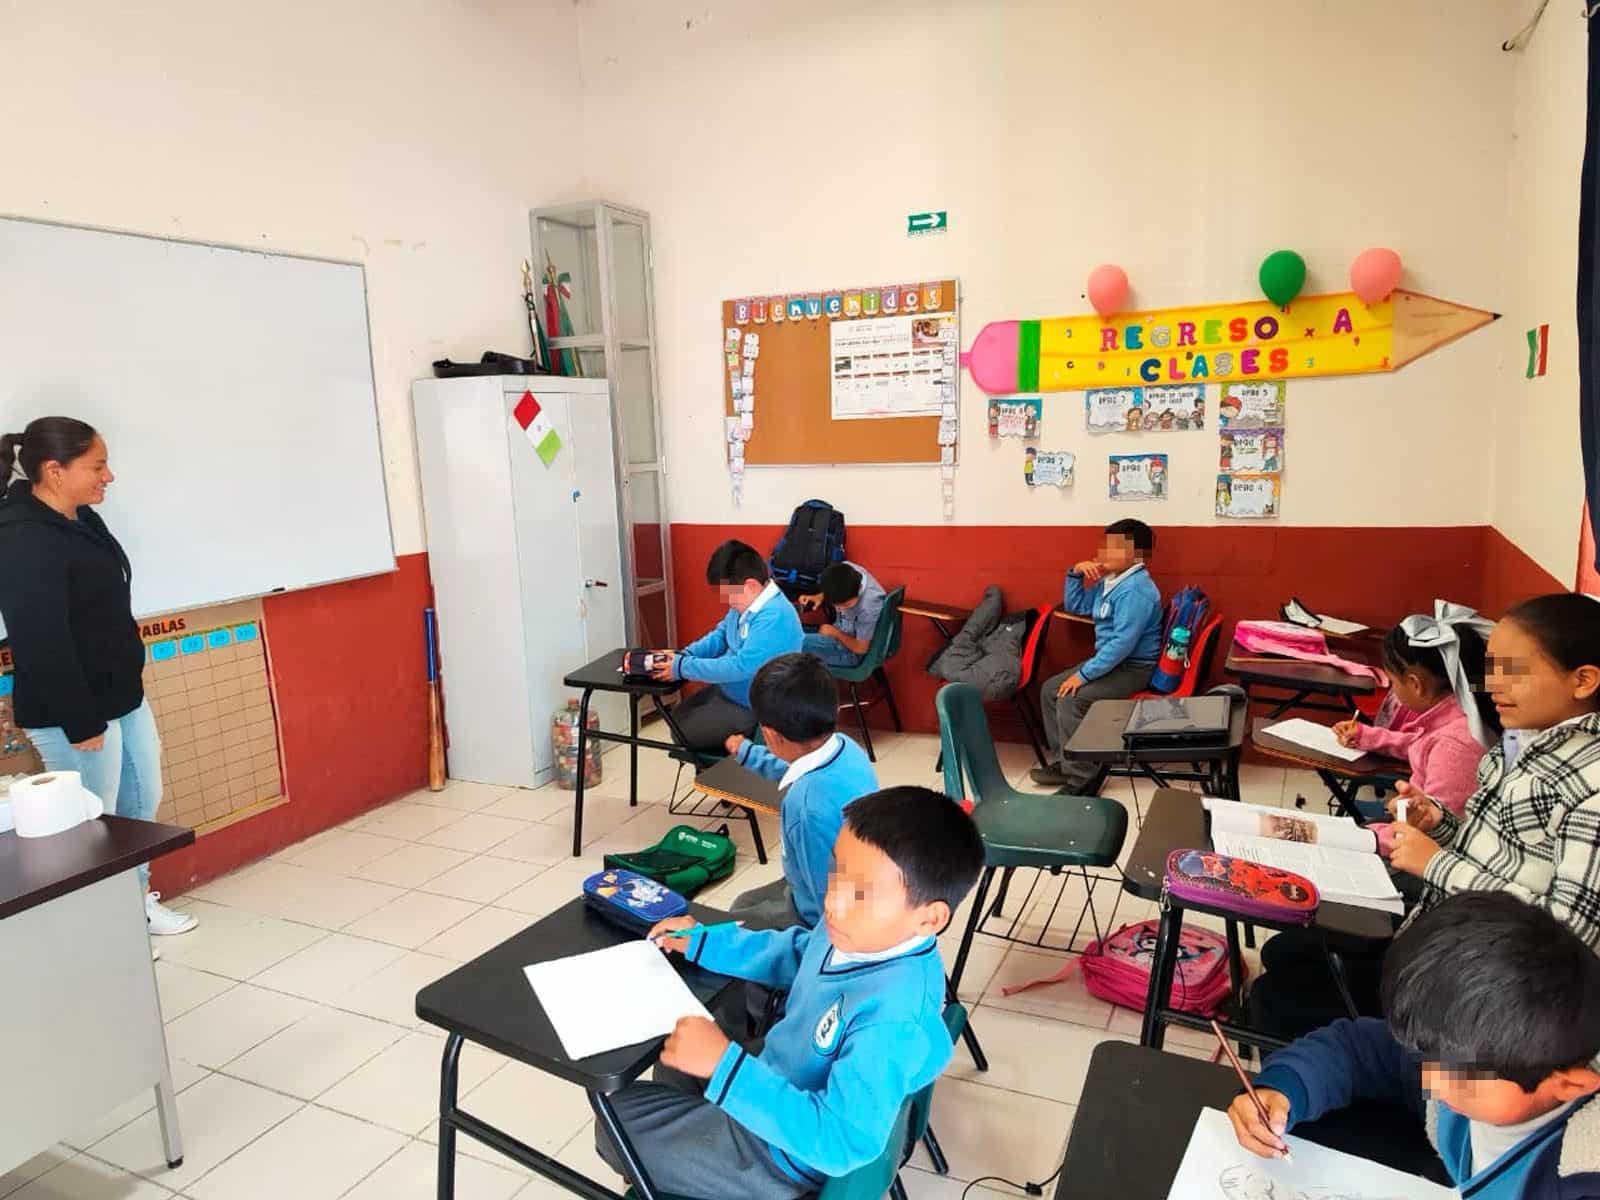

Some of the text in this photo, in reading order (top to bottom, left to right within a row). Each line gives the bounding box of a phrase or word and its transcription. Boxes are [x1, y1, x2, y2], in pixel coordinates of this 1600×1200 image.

[1099, 307, 1353, 352] REGRESO A
[1140, 347, 1289, 382] CLASES
